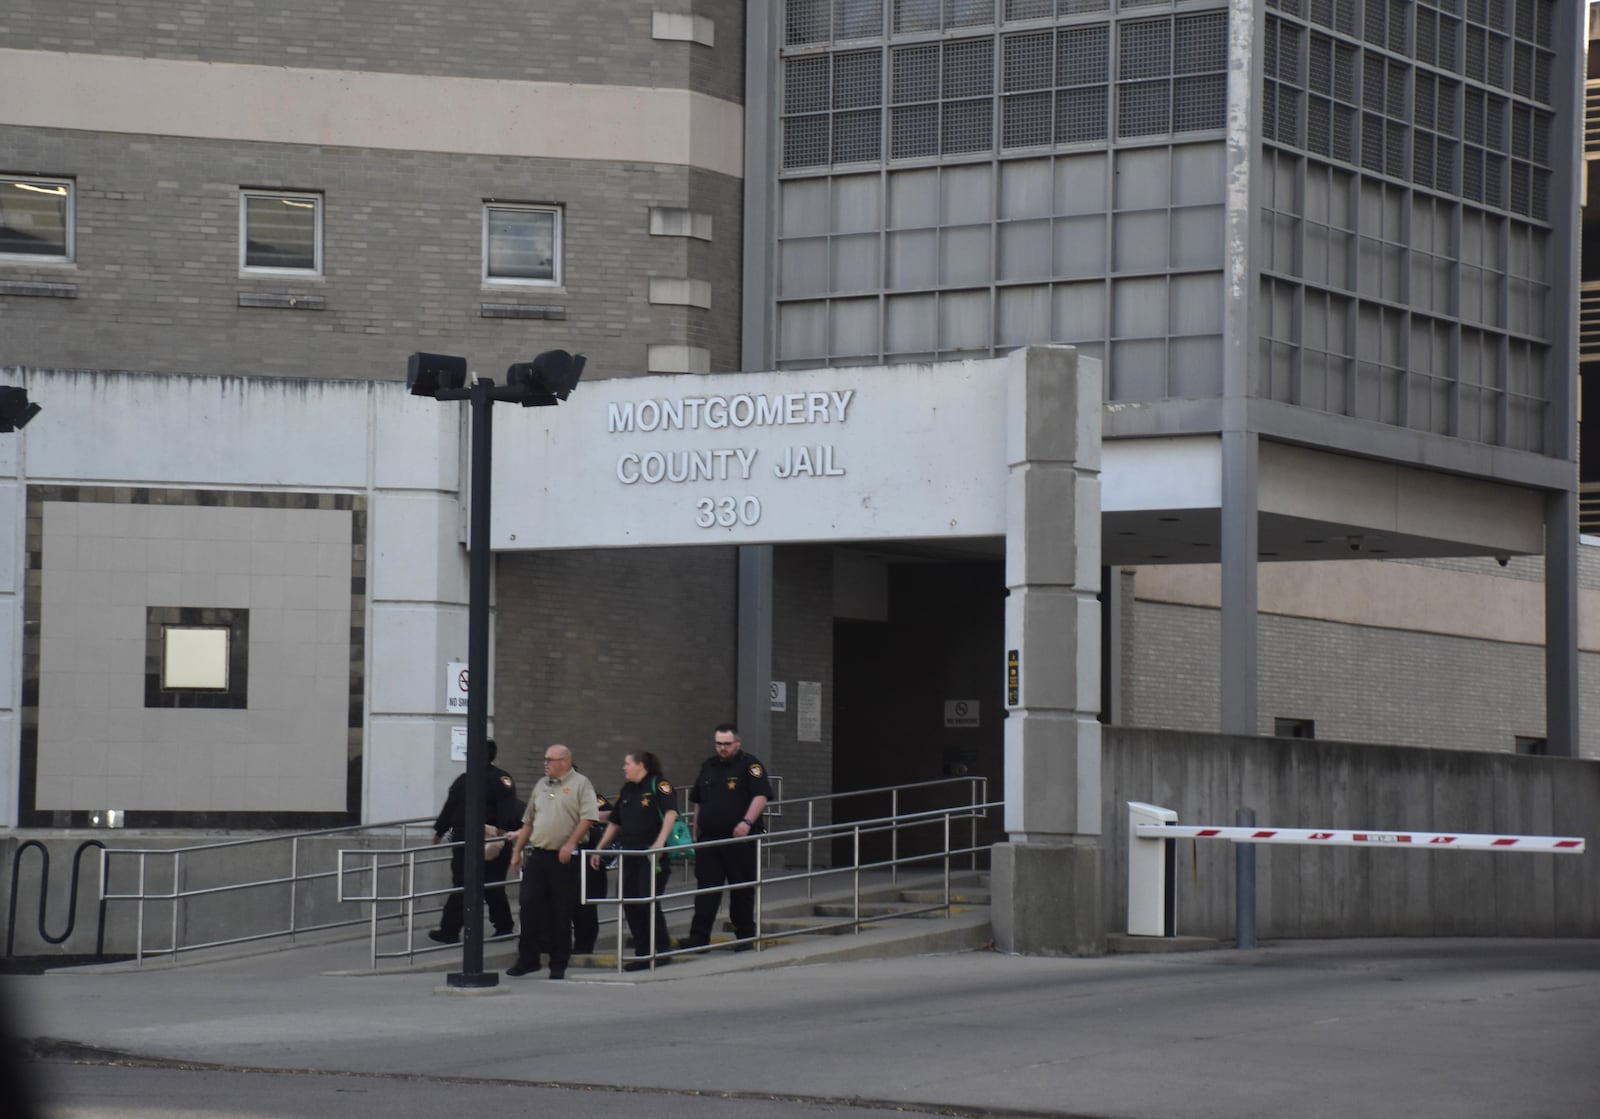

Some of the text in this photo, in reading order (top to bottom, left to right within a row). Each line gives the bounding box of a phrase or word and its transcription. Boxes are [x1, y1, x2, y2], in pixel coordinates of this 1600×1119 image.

[608, 390, 856, 433] MONTGOMERY
[616, 445, 846, 485] COUNTY JAIL
[695, 495, 762, 528] 330
